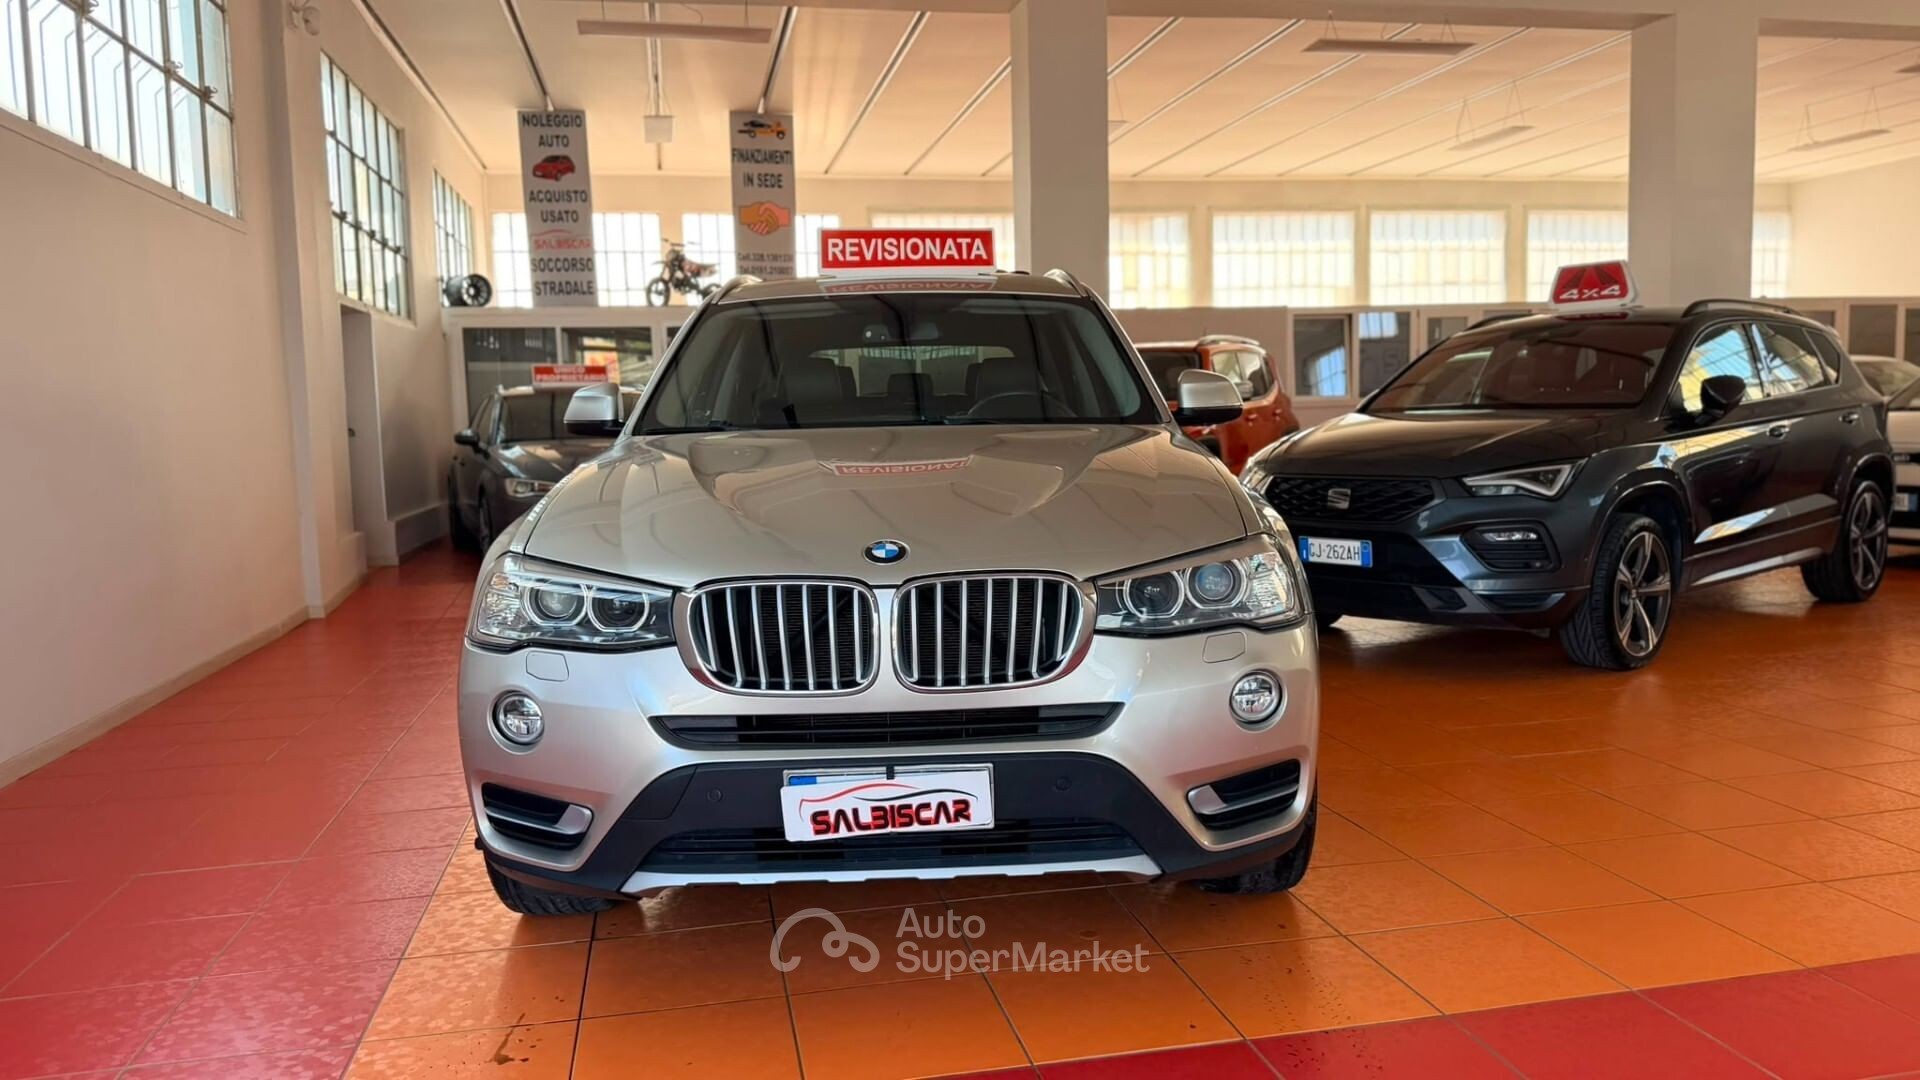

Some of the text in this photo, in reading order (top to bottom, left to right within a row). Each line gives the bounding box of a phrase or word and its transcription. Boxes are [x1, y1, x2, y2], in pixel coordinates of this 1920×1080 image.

[522, 114, 583, 128] NOLEGGIO
[538, 134, 570, 148] AUTO
[732, 148, 793, 165] FINANZIAMENTI
[743, 172, 783, 189] IN SEDE
[528, 189, 588, 203] ACQUISTO
[540, 210, 580, 223] USATO
[827, 237, 988, 261] REVISIONATA
[531, 257, 594, 273] SOCCORSO
[534, 281, 595, 296] STRADALE
[810, 798, 972, 836] SALBISCAR
